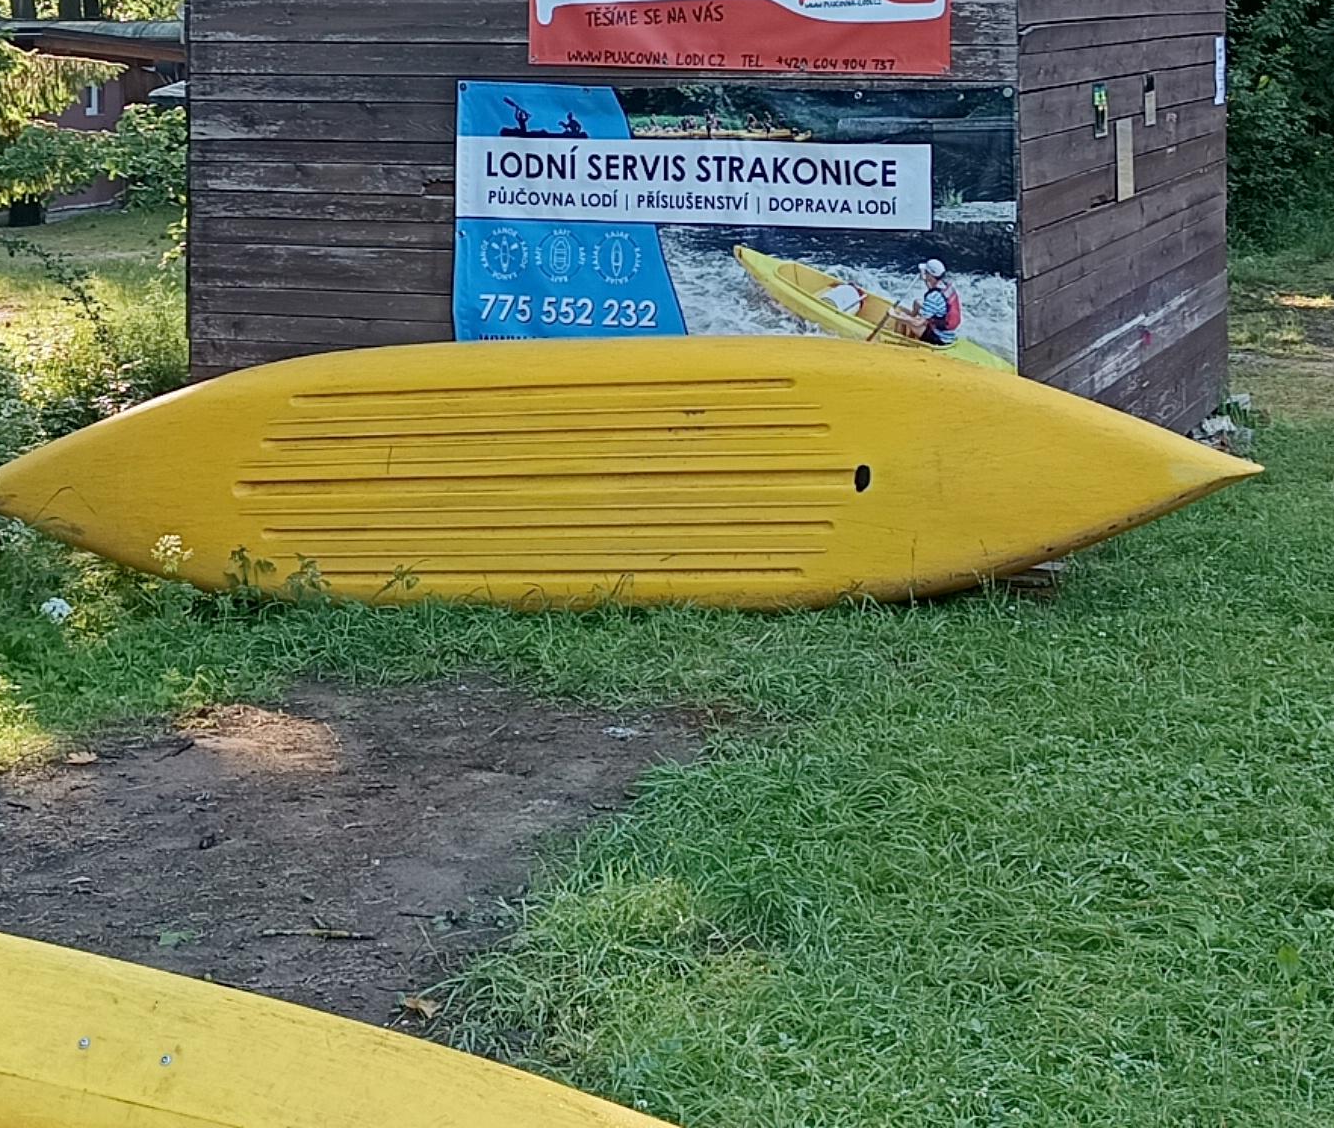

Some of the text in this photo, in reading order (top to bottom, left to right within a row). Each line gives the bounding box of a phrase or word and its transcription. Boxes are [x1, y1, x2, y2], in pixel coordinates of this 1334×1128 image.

[585, 1, 724, 28] TĚŠÍME SE NA VÁS
[812, 57, 838, 70] 604
[842, 58, 867, 70] 904
[871, 58, 896, 71] 737
[486, 145, 897, 187] LODNÍ SERVIS STRAKONICE
[488, 186, 576, 207] PŮJČOVNA
[581, 189, 618, 208] LODÍ
[637, 189, 750, 210] PŘÍSLUŠENSTVÍ
[769, 197, 852, 213] DOPRAVA
[857, 196, 897, 215] LODÍ
[479, 293, 657, 328] 775 552 232
